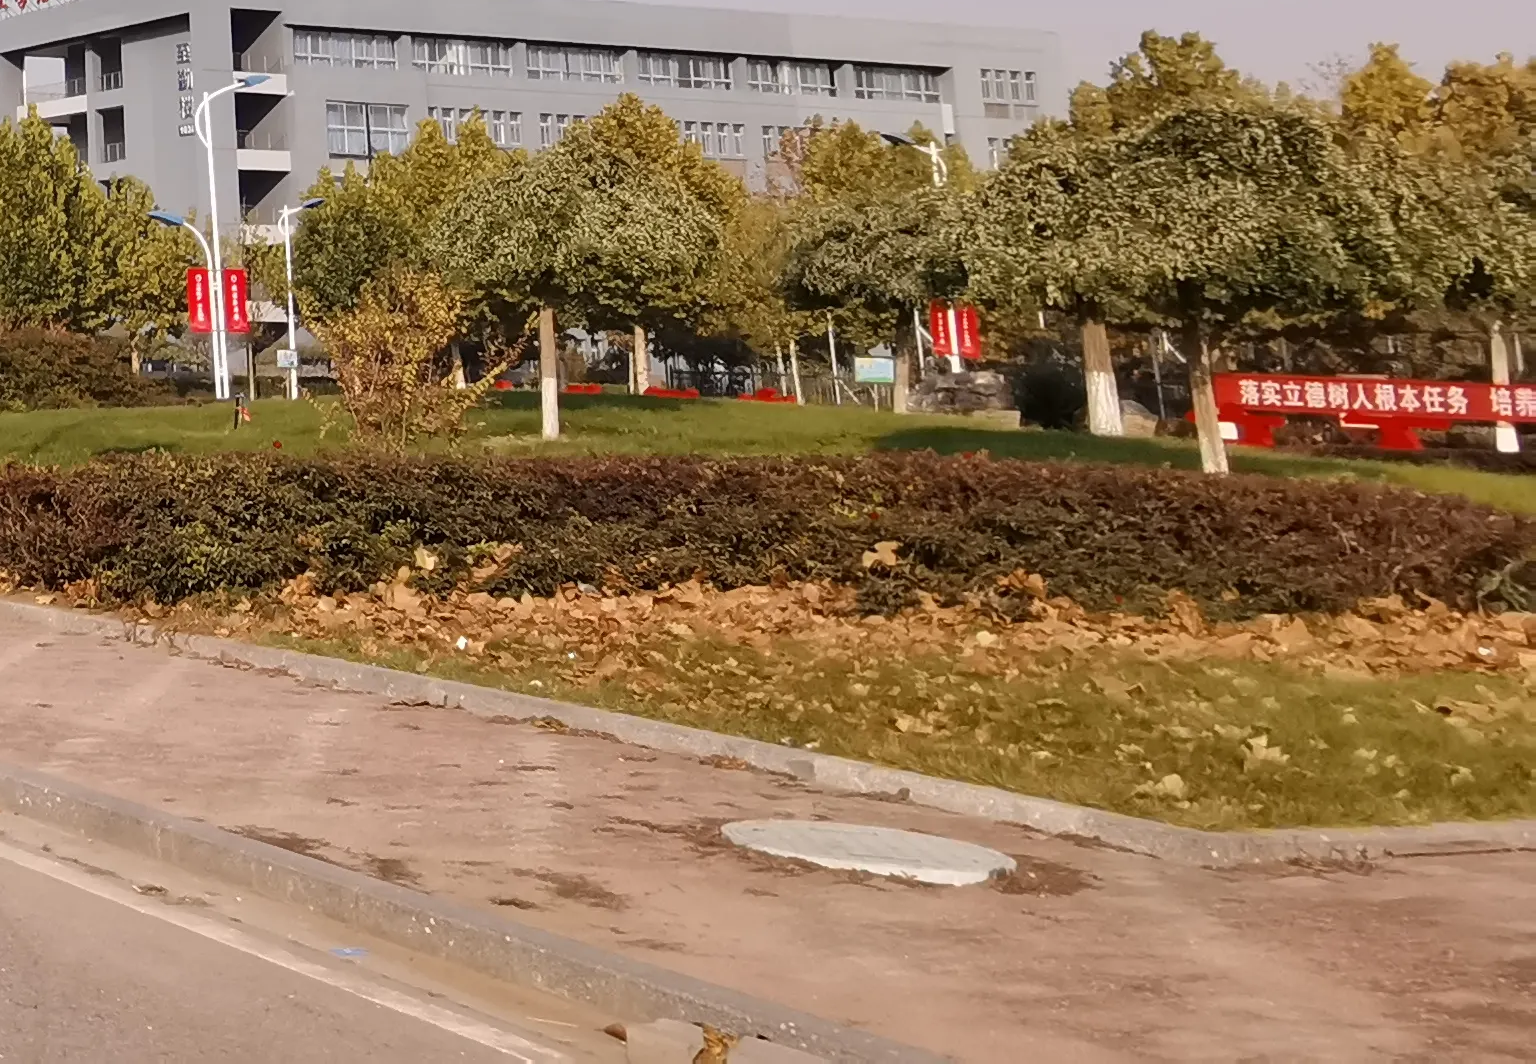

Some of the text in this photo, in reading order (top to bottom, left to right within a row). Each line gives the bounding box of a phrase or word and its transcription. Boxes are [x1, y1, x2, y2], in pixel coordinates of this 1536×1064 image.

[1238, 378, 1469, 415] 落实立德树人根本任务
